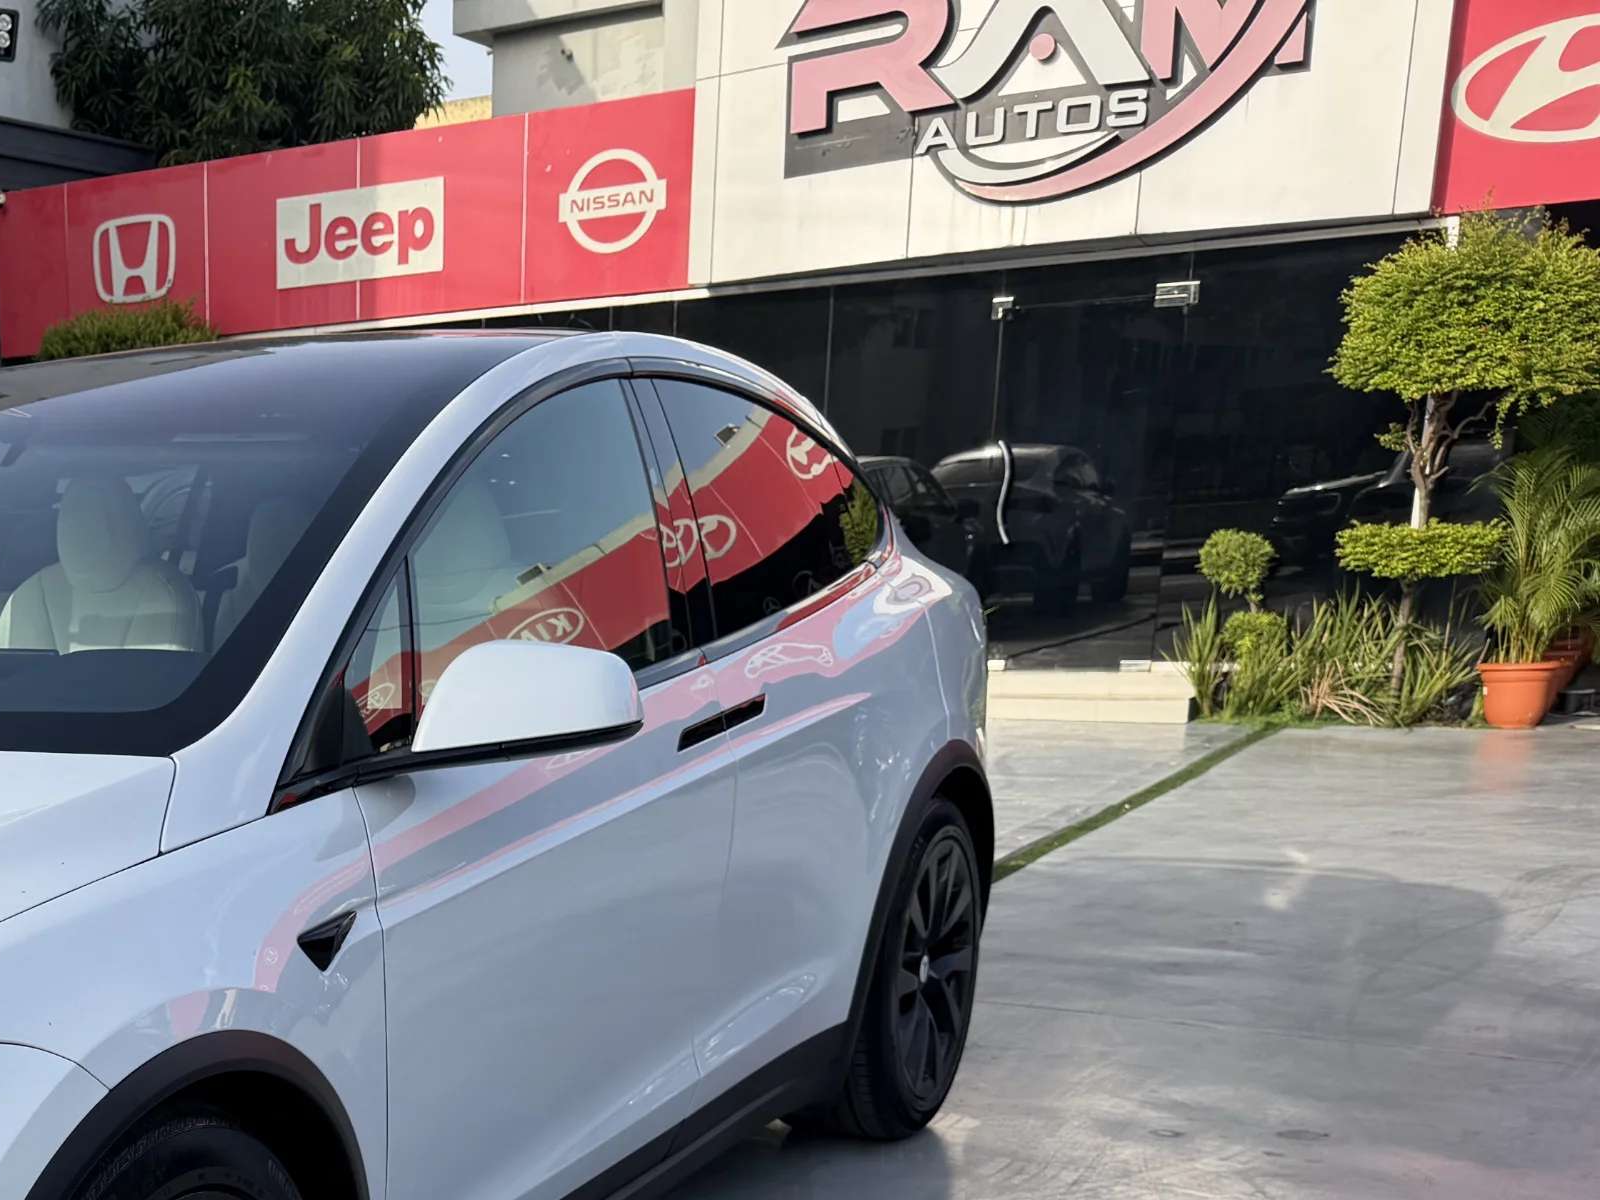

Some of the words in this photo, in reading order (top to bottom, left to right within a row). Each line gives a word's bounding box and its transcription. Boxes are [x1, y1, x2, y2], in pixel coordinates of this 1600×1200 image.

[915, 88, 1150, 155] AUTOS
[569, 187, 655, 214] NISSAN
[284, 203, 435, 266] Jeep
